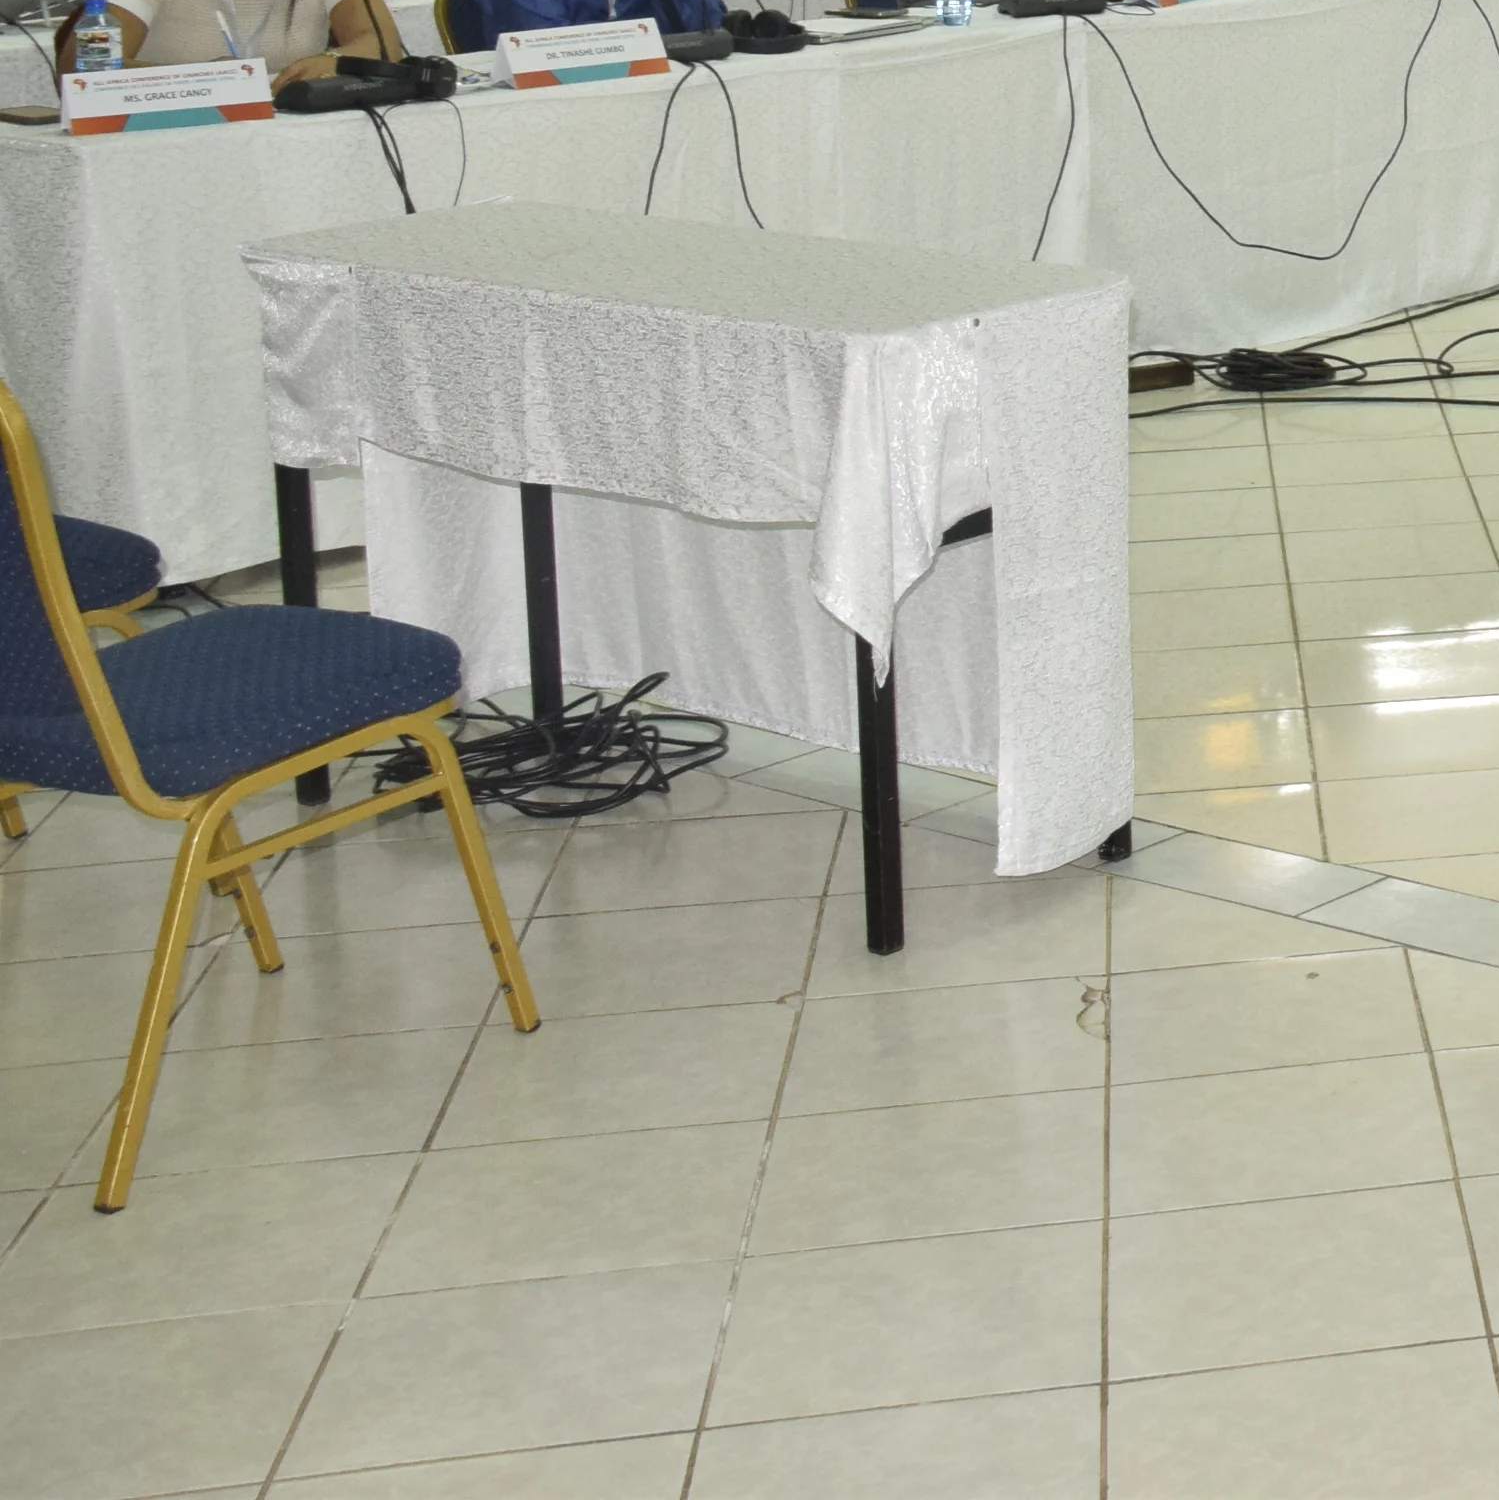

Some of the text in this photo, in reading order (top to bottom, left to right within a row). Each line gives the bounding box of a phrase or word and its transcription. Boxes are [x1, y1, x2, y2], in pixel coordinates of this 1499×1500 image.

[561, 47, 594, 58] TINASHE
[123, 94, 142, 104] MS.
[145, 90, 178, 102] GRACE
